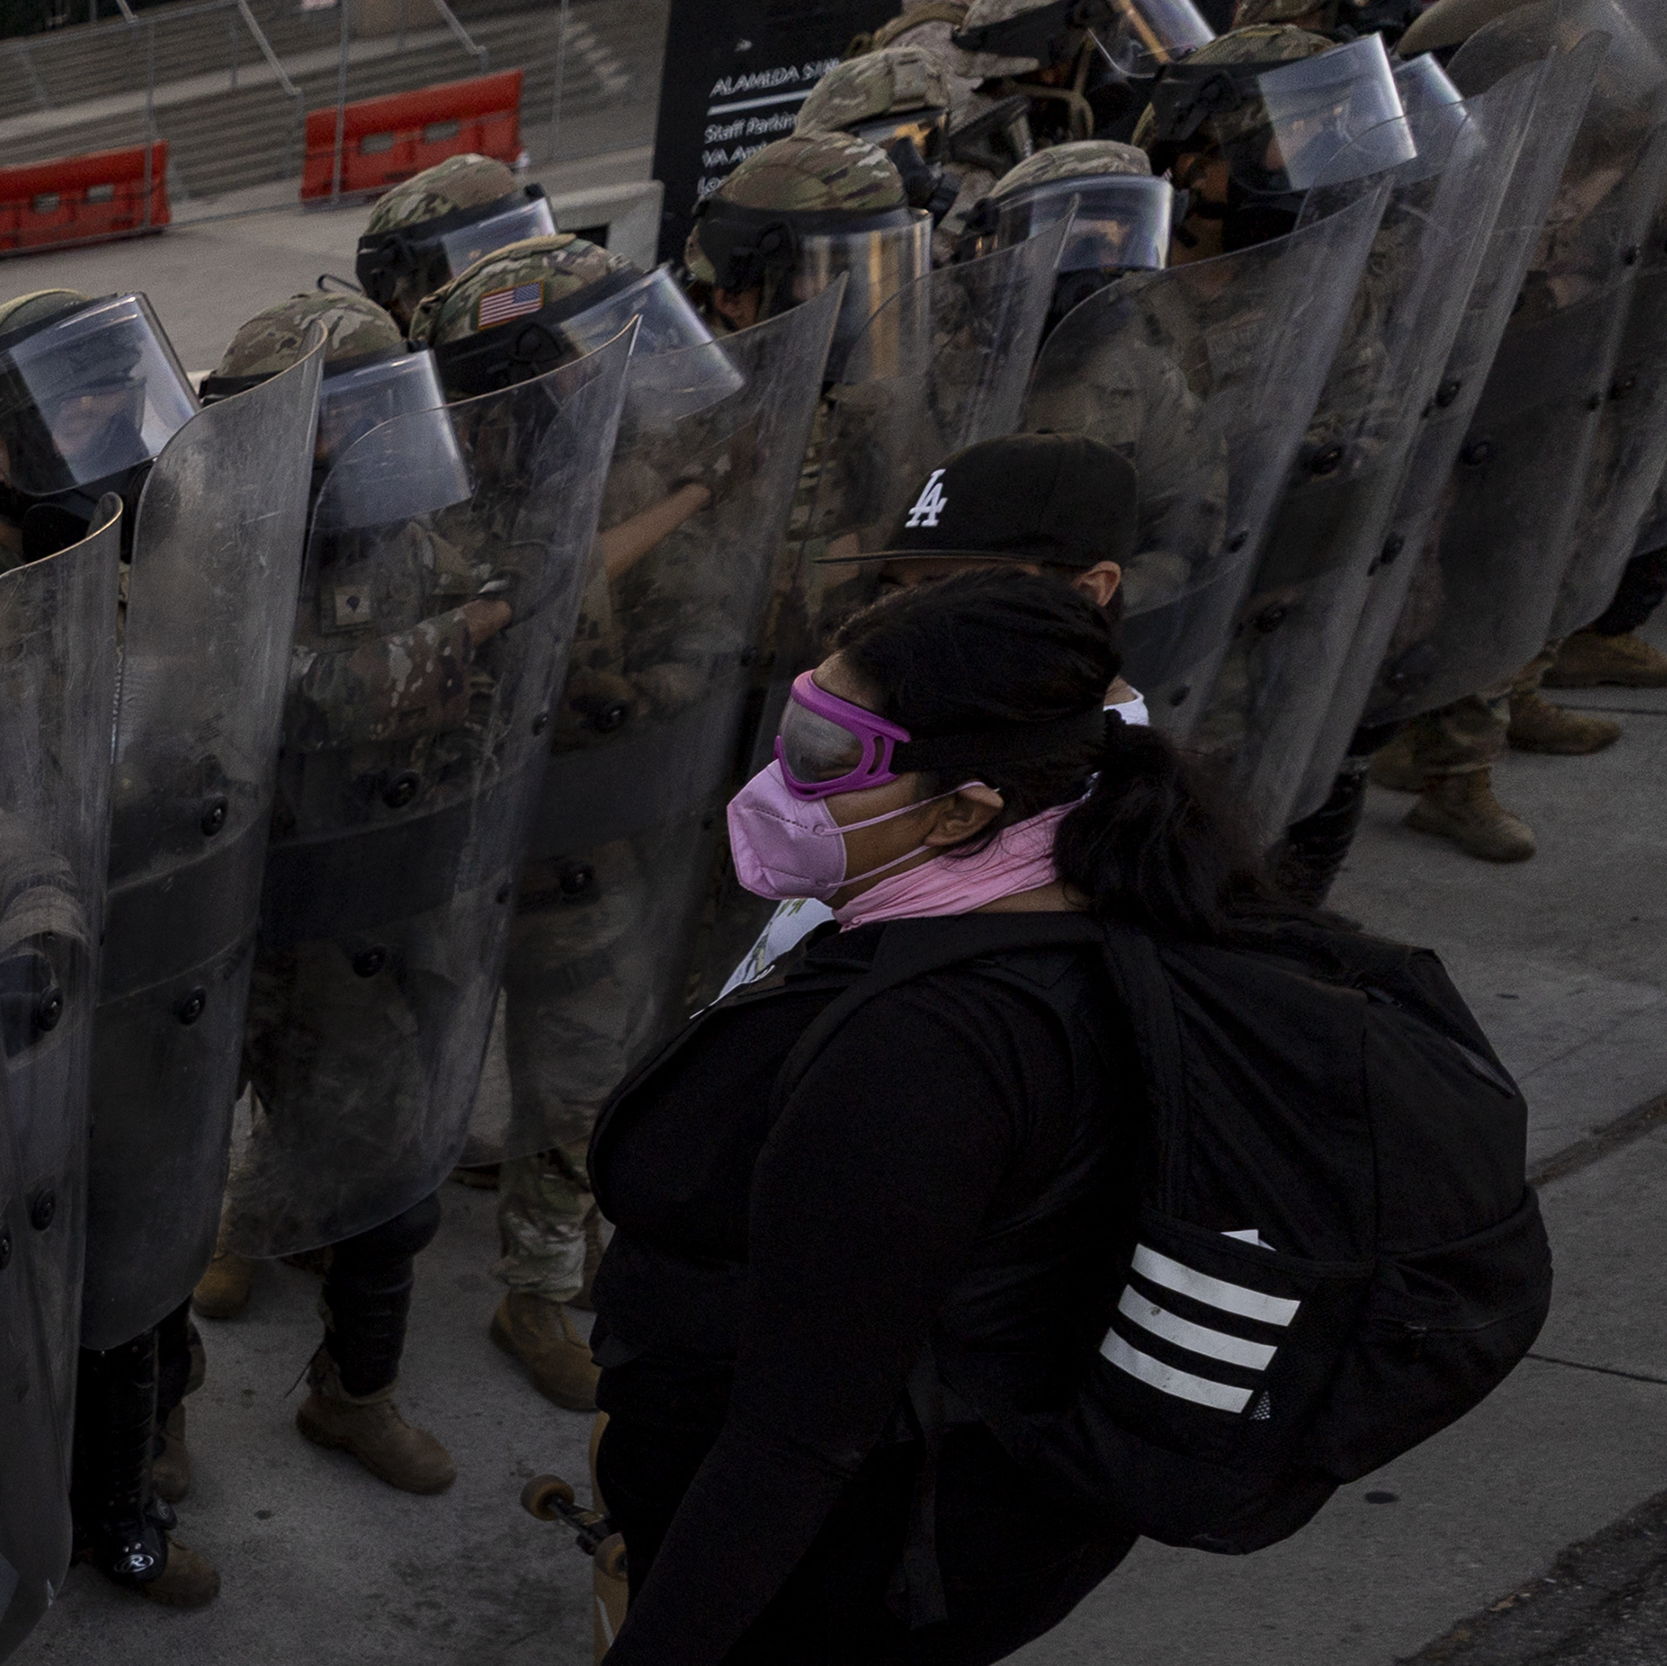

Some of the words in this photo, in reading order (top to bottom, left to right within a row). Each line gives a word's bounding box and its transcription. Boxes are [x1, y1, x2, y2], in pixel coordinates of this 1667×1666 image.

[709, 65, 799, 98] ALAMEDA
[704, 119, 744, 144] Staff
[745, 111, 798, 136] Parkin
[702, 148, 728, 168] VA
[904, 468, 949, 528] LA
